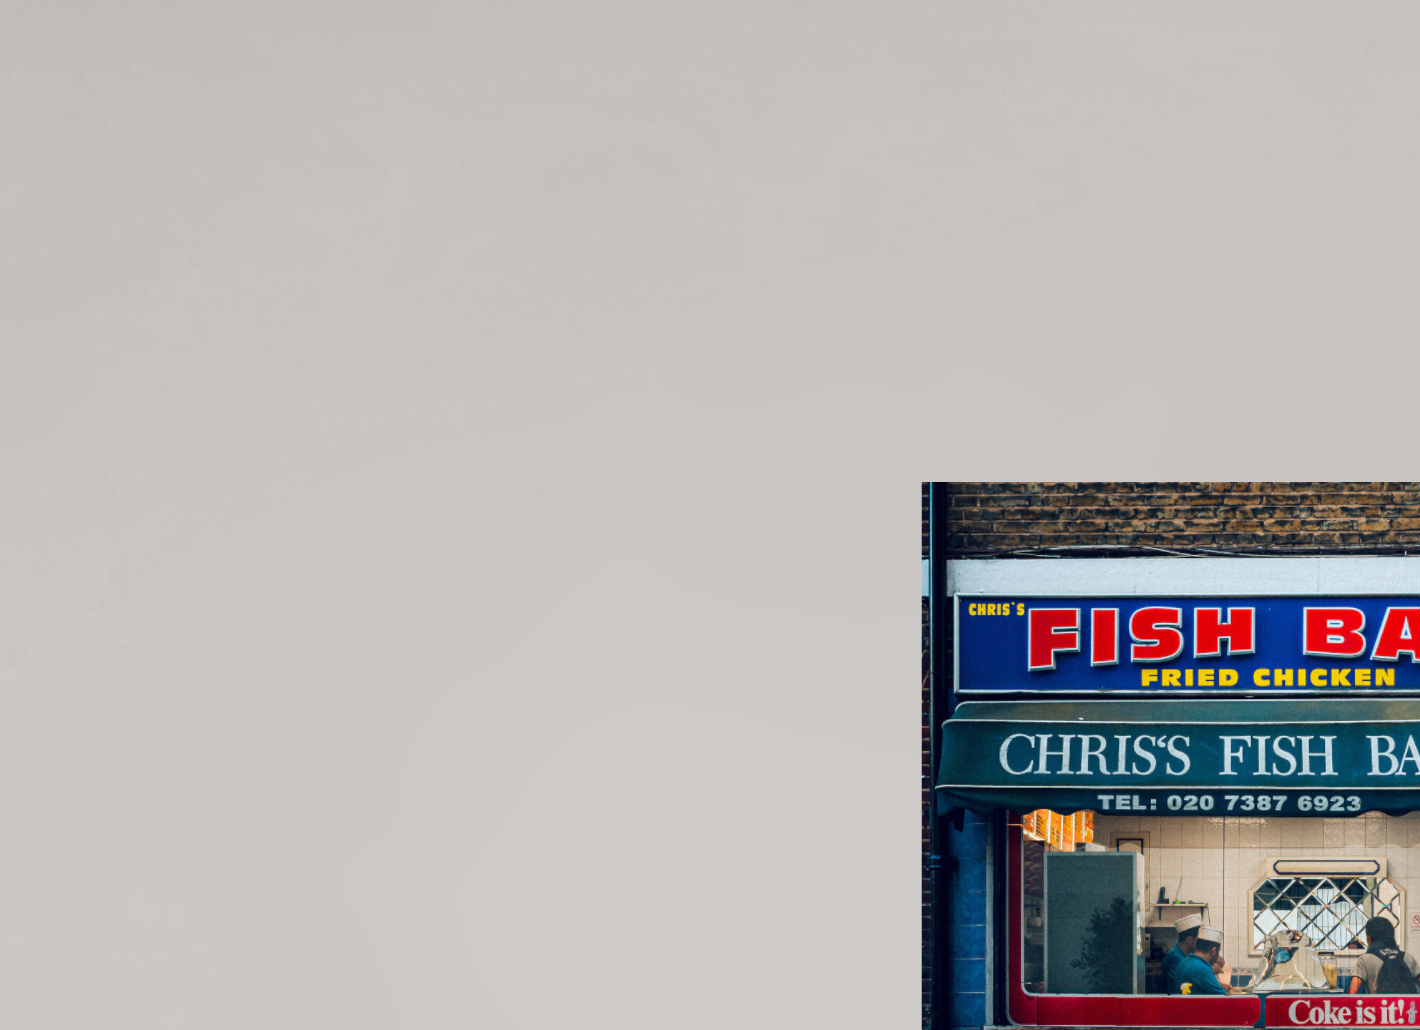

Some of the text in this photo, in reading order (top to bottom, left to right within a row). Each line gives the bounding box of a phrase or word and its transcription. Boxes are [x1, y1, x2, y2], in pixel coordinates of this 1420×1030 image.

[1028, 606, 1256, 672] FISH
[1140, 668, 1396, 687] FRIED CHICKEN
[1218, 735, 1339, 776] FISH
[1097, 795, 1362, 811] TEL: 020 7387 6923
[1288, 999, 1405, 1024] Coke is it!
